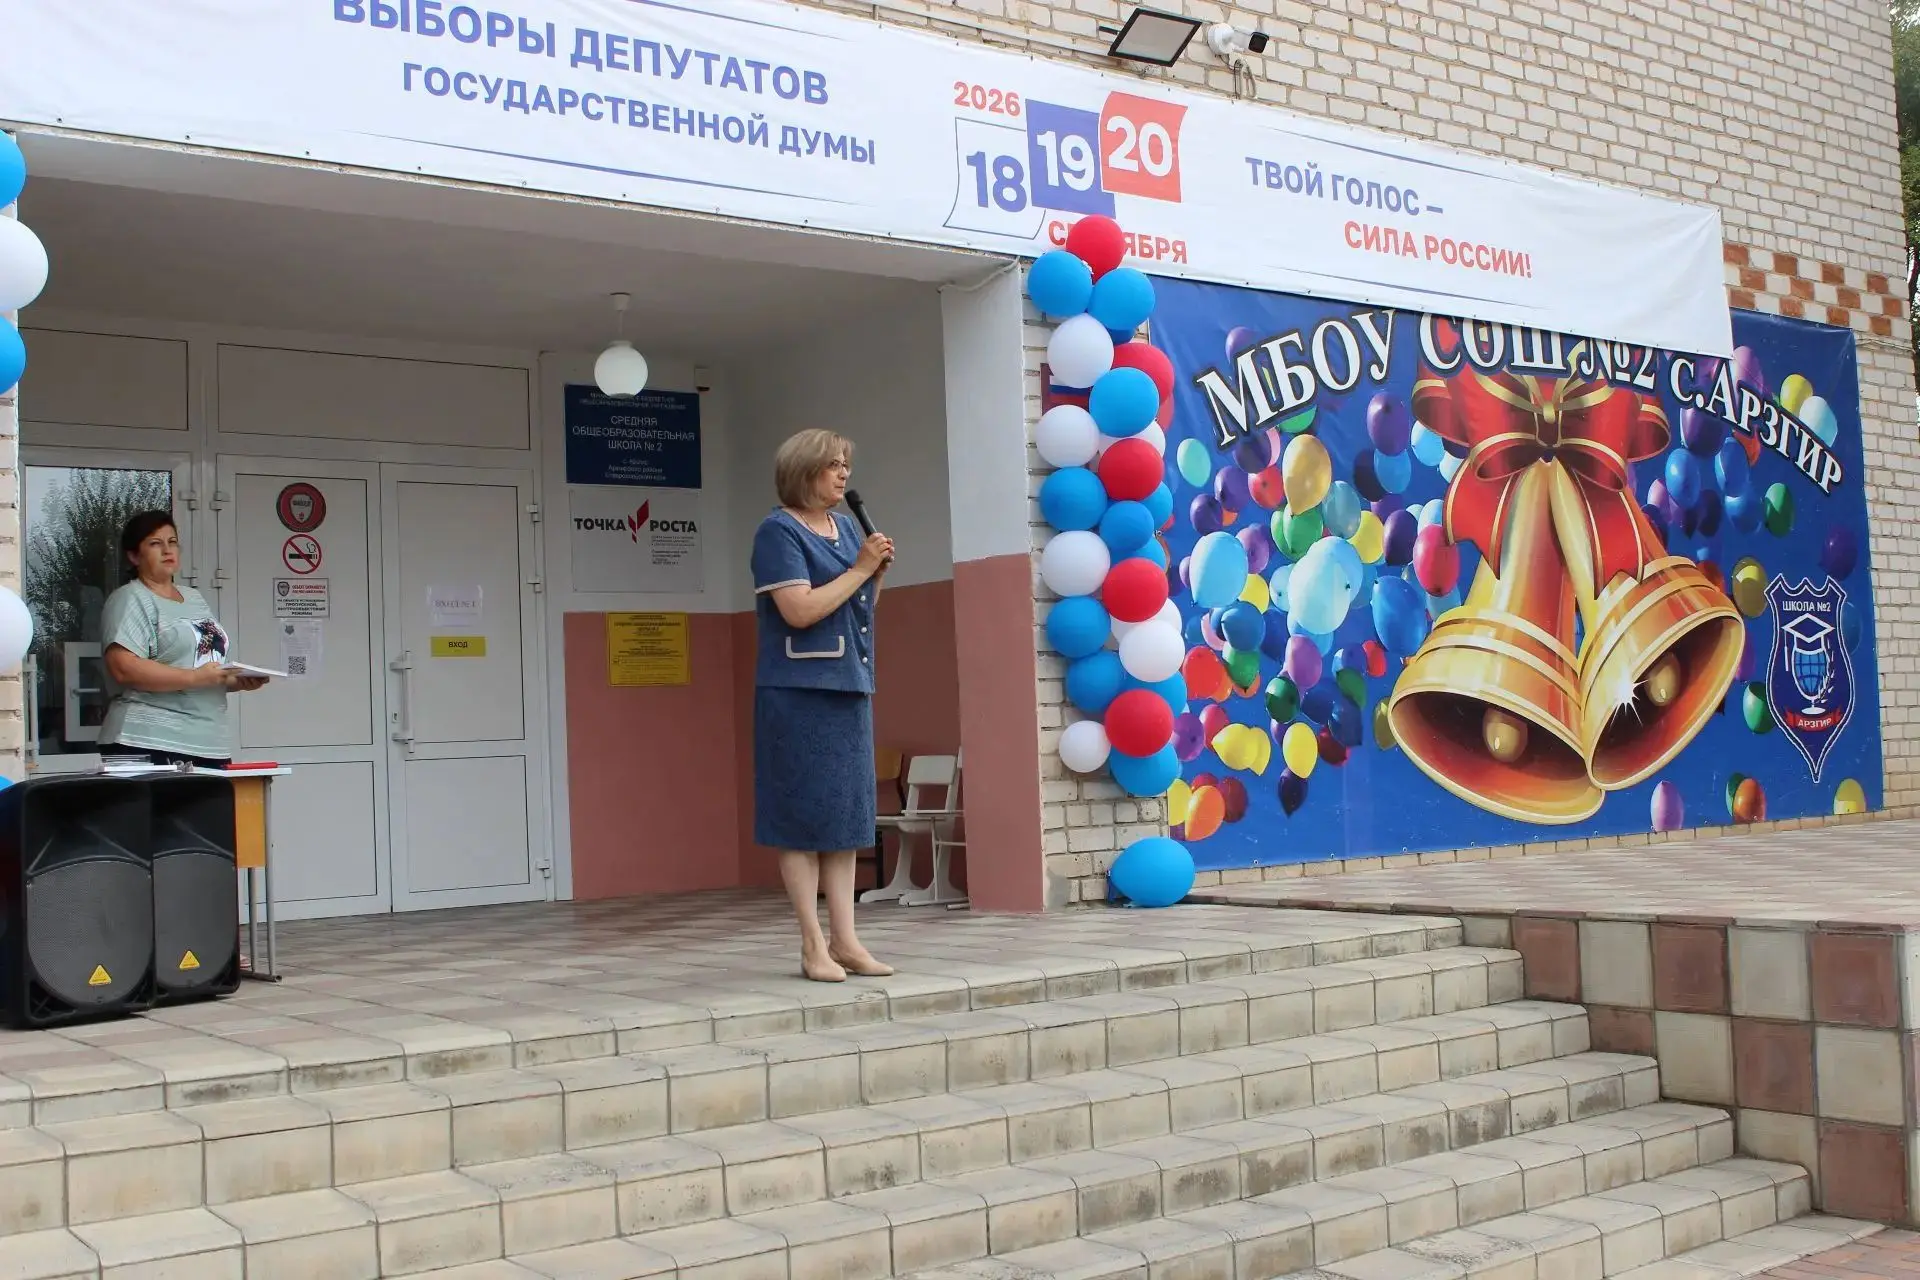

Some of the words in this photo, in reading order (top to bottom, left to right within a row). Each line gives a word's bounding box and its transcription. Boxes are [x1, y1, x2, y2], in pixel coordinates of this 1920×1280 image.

[334, 0, 555, 57] ВЫБОРЫ
[570, 28, 829, 105] ДЕПУТАТОВ
[403, 62, 768, 148] ГОСУДАРСТВЕННОЙ
[779, 125, 875, 165] ДУМЫ
[954, 81, 1020, 117] 2026
[1037, 131, 1094, 191] 19
[1106, 116, 1172, 177] 20
[966, 151, 1027, 212] 18
[1245, 157, 1323, 198] ТВОЙ
[1331, 174, 1419, 215] ГОЛОС
[1048, 221, 1188, 264] СЯБРЯ
[1344, 221, 1419, 259] СИЛА
[1425, 235, 1532, 278] РОССИИ!
[1196, 309, 1396, 446] МБОУ
[1420, 313, 1566, 370] СОШ
[1580, 338, 1656, 389] №2
[572, 426, 695, 440] ОБЩЕОБРАЗОВАТЕЛЬНАЯ
[611, 416, 658, 426] СРЕДНЯЯ
[608, 440, 641, 450] ШКОЛА
[657, 443, 663, 452] 2
[574, 518, 626, 531] ТОЧКА
[650, 520, 698, 532] РОСТА
[1783, 601, 1815, 612] ШКОЛА
[1816, 601, 1831, 612] №2
[448, 641, 468, 649] ВХОД
[1798, 718, 1832, 729] АРЗГИР
